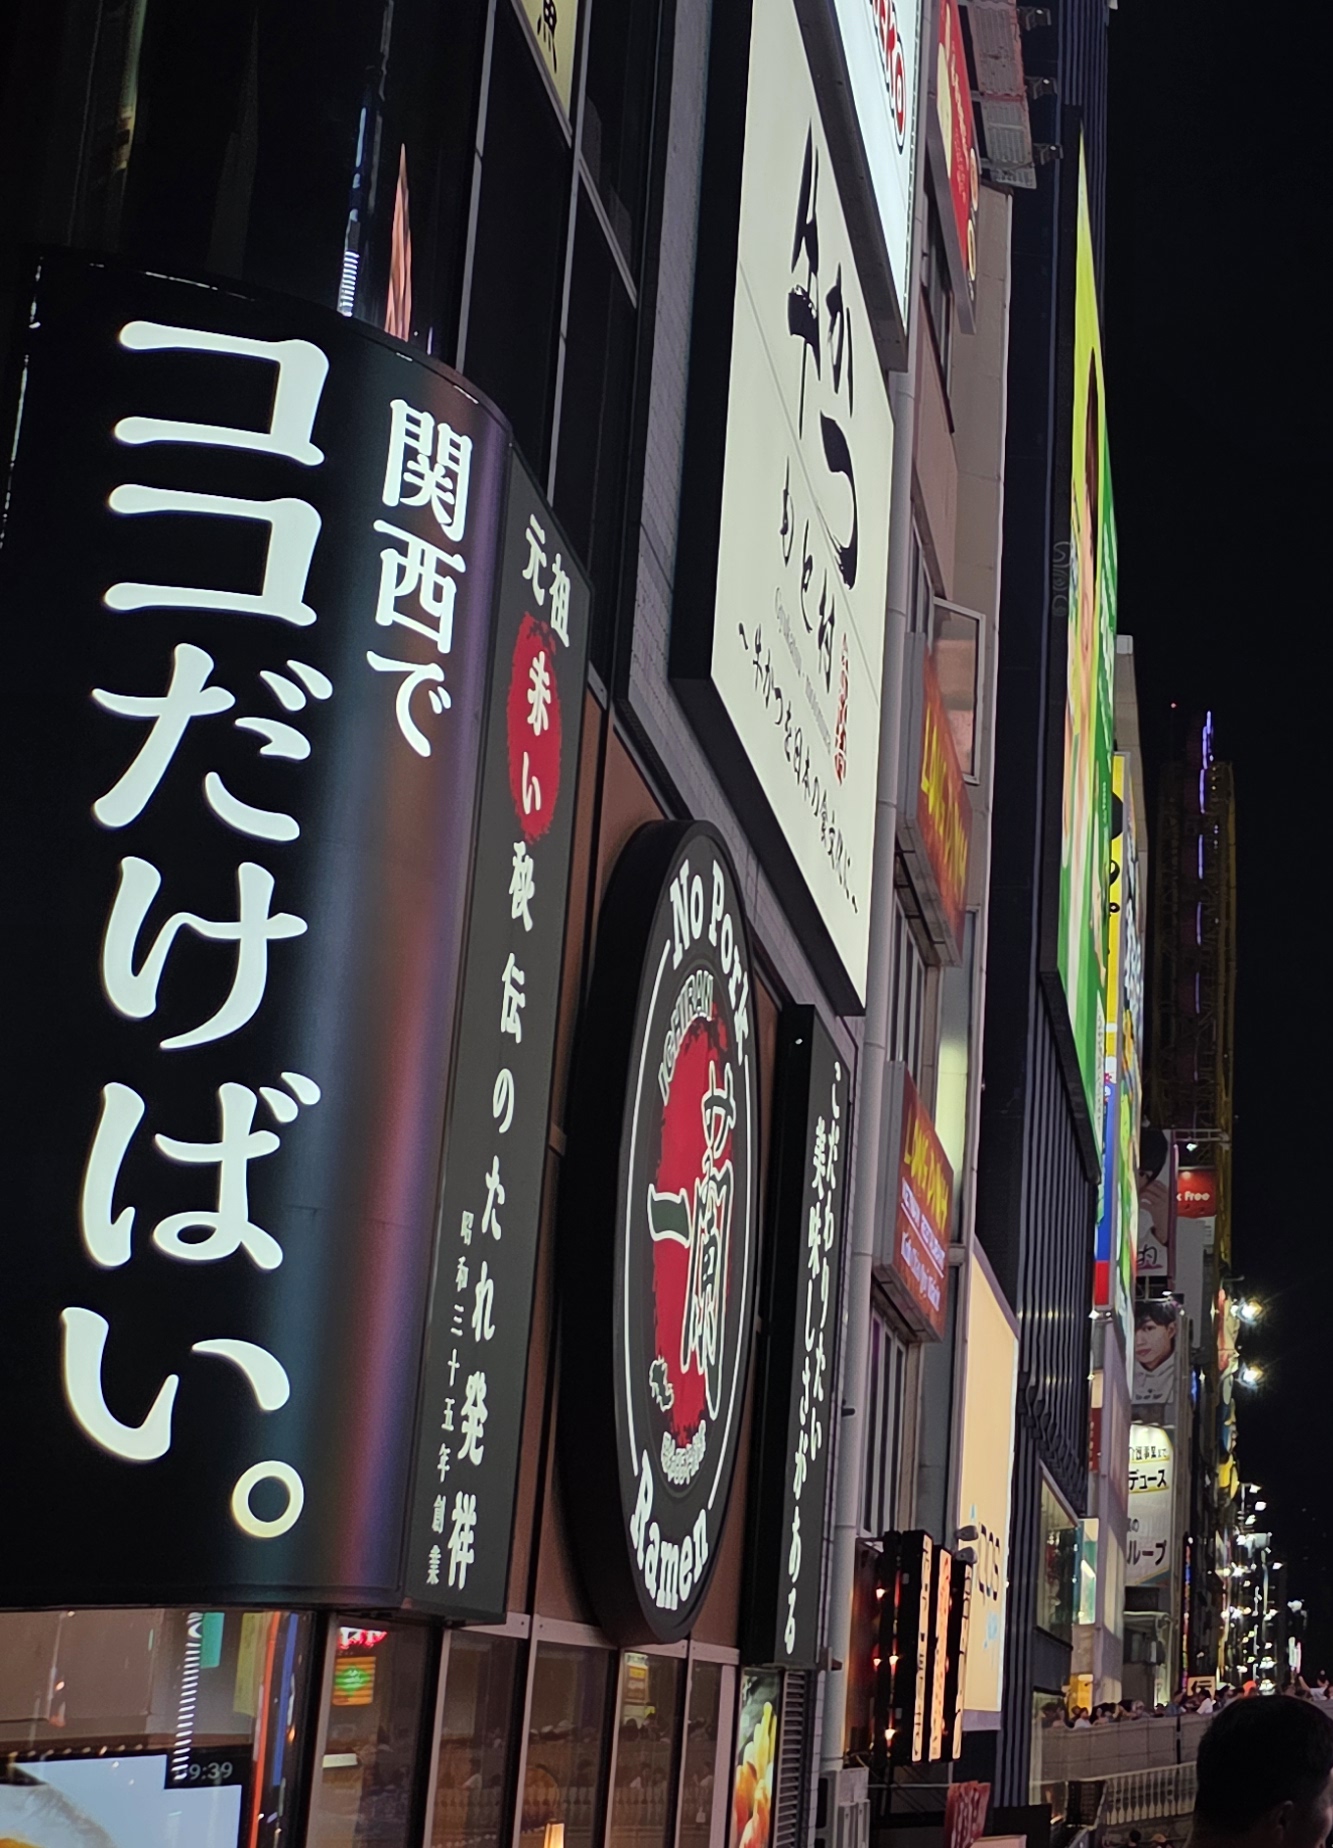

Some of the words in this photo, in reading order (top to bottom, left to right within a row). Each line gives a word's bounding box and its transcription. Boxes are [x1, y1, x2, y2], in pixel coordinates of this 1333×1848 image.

[367, 399, 472, 757] 関西で
[525, 514, 570, 648] 元祖
[61, 320, 333, 1538] ココだけばい。
[668, 859, 703, 969] No
[708, 859, 750, 1066] Pork
[630, 1449, 709, 1611] Ramen
